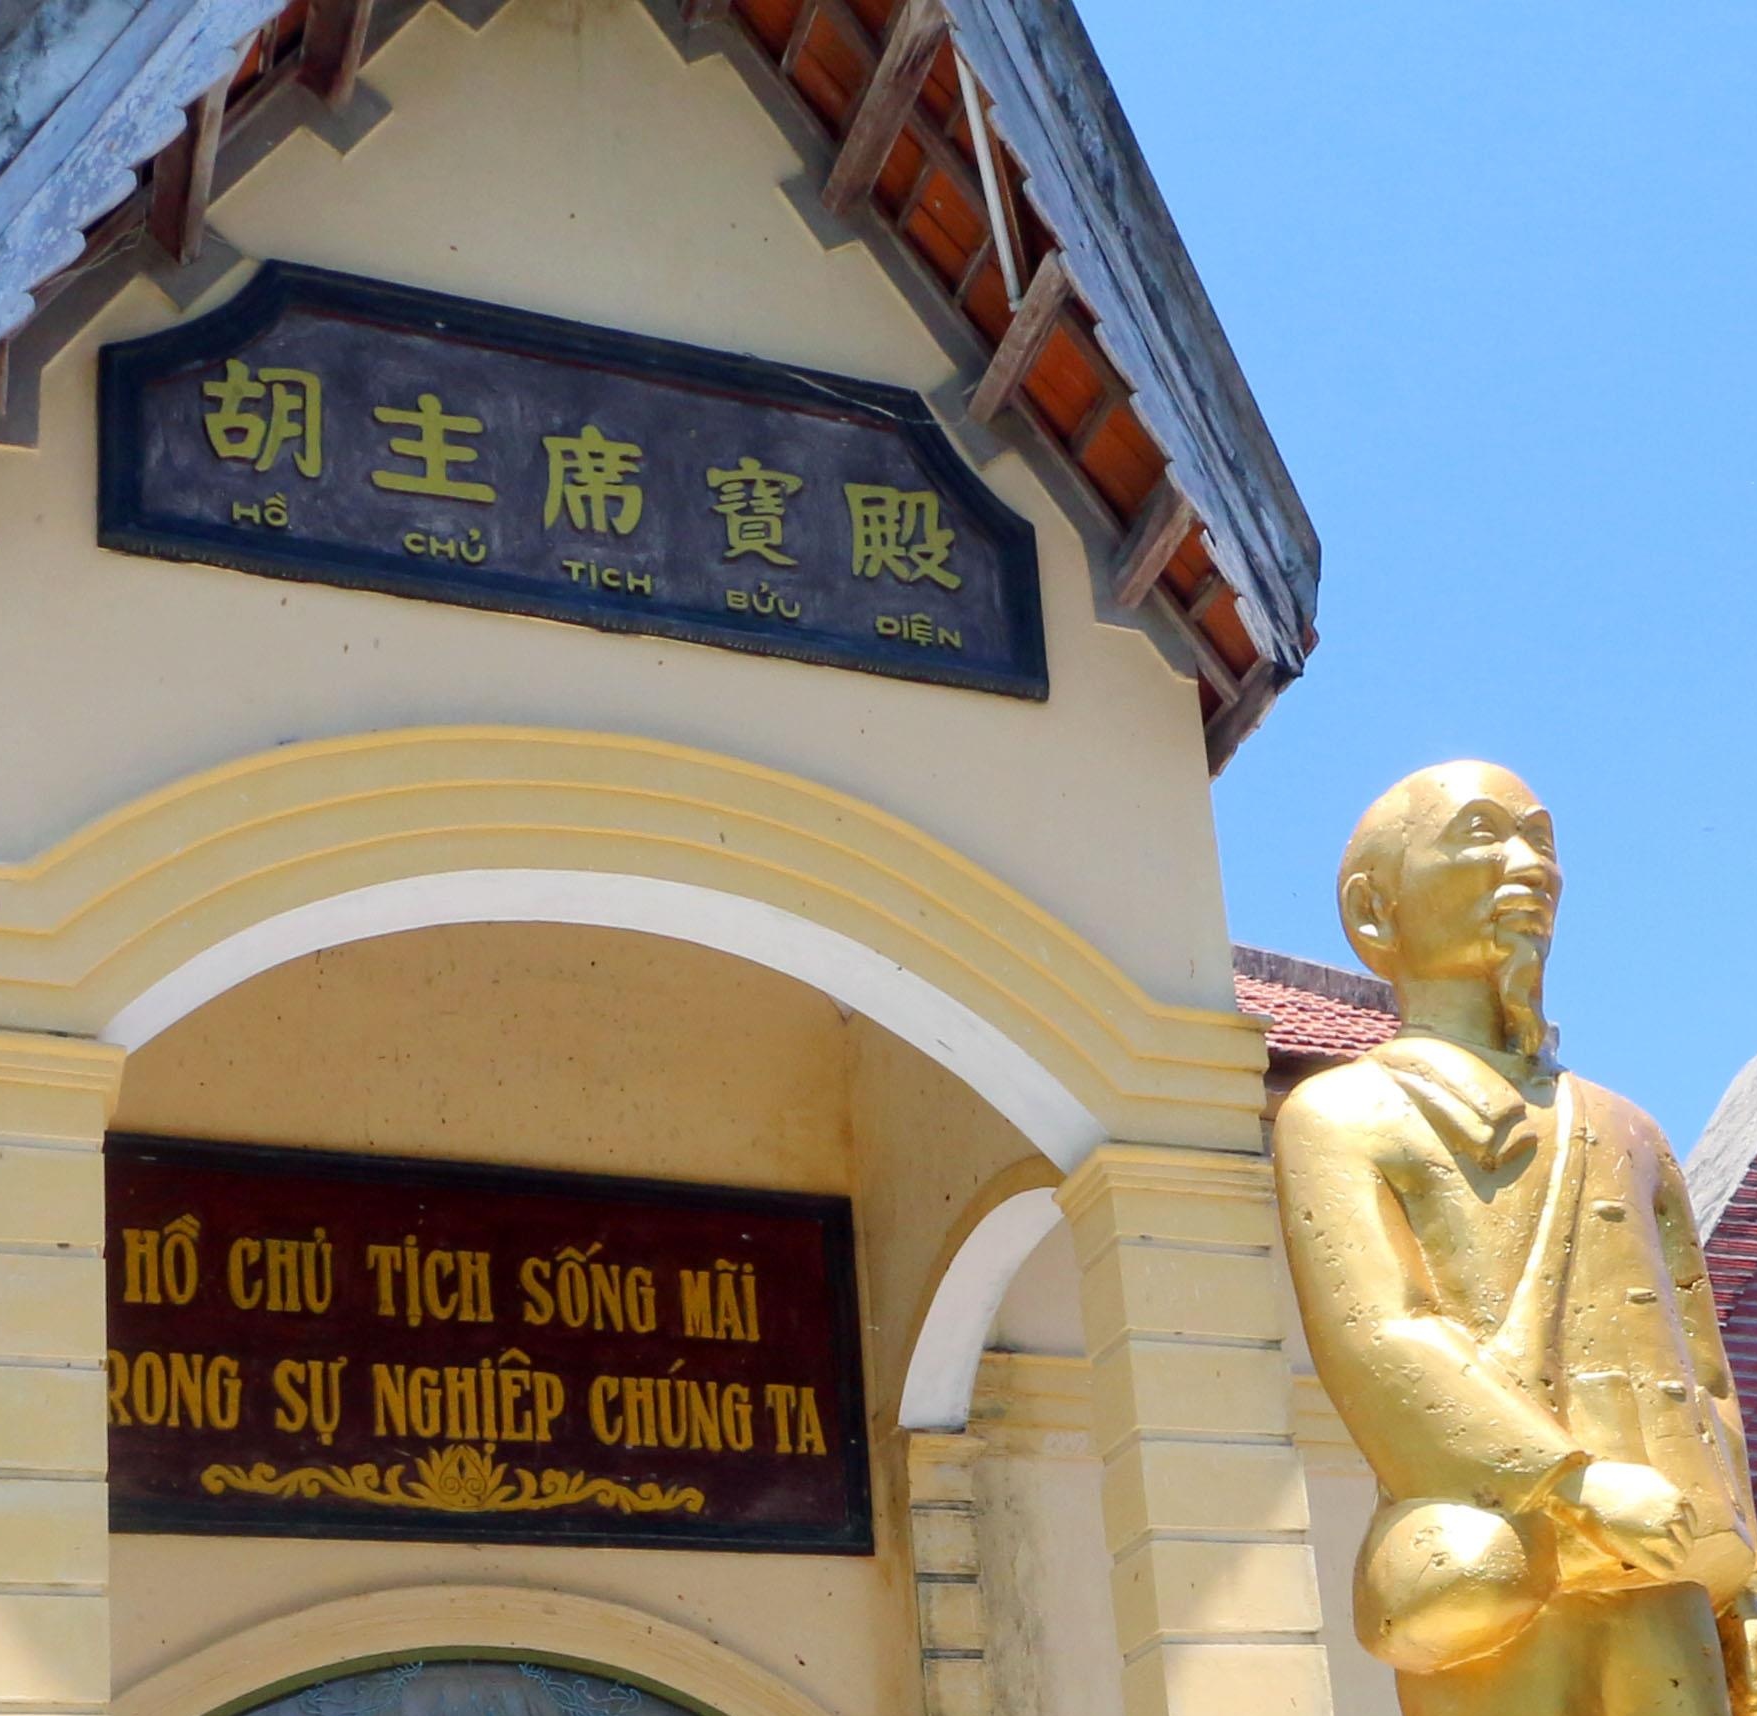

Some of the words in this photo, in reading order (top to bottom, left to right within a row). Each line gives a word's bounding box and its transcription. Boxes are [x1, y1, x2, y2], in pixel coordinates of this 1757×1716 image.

[232, 491, 289, 528] HỒ
[402, 527, 487, 564] CHỦ
[725, 581, 802, 619] BỬU
[874, 611, 963, 650] ĐIỆN
[121, 1213, 202, 1306] HỒ
[227, 1226, 333, 1314] CHỦ
[366, 1234, 495, 1328] TỊCH
[518, 1241, 658, 1334] SỐNG
[679, 1257, 761, 1343] MÃI
[272, 1356, 349, 1447] SỰ
[588, 1357, 754, 1452] CHÚNG
[764, 1383, 828, 1457] TA
